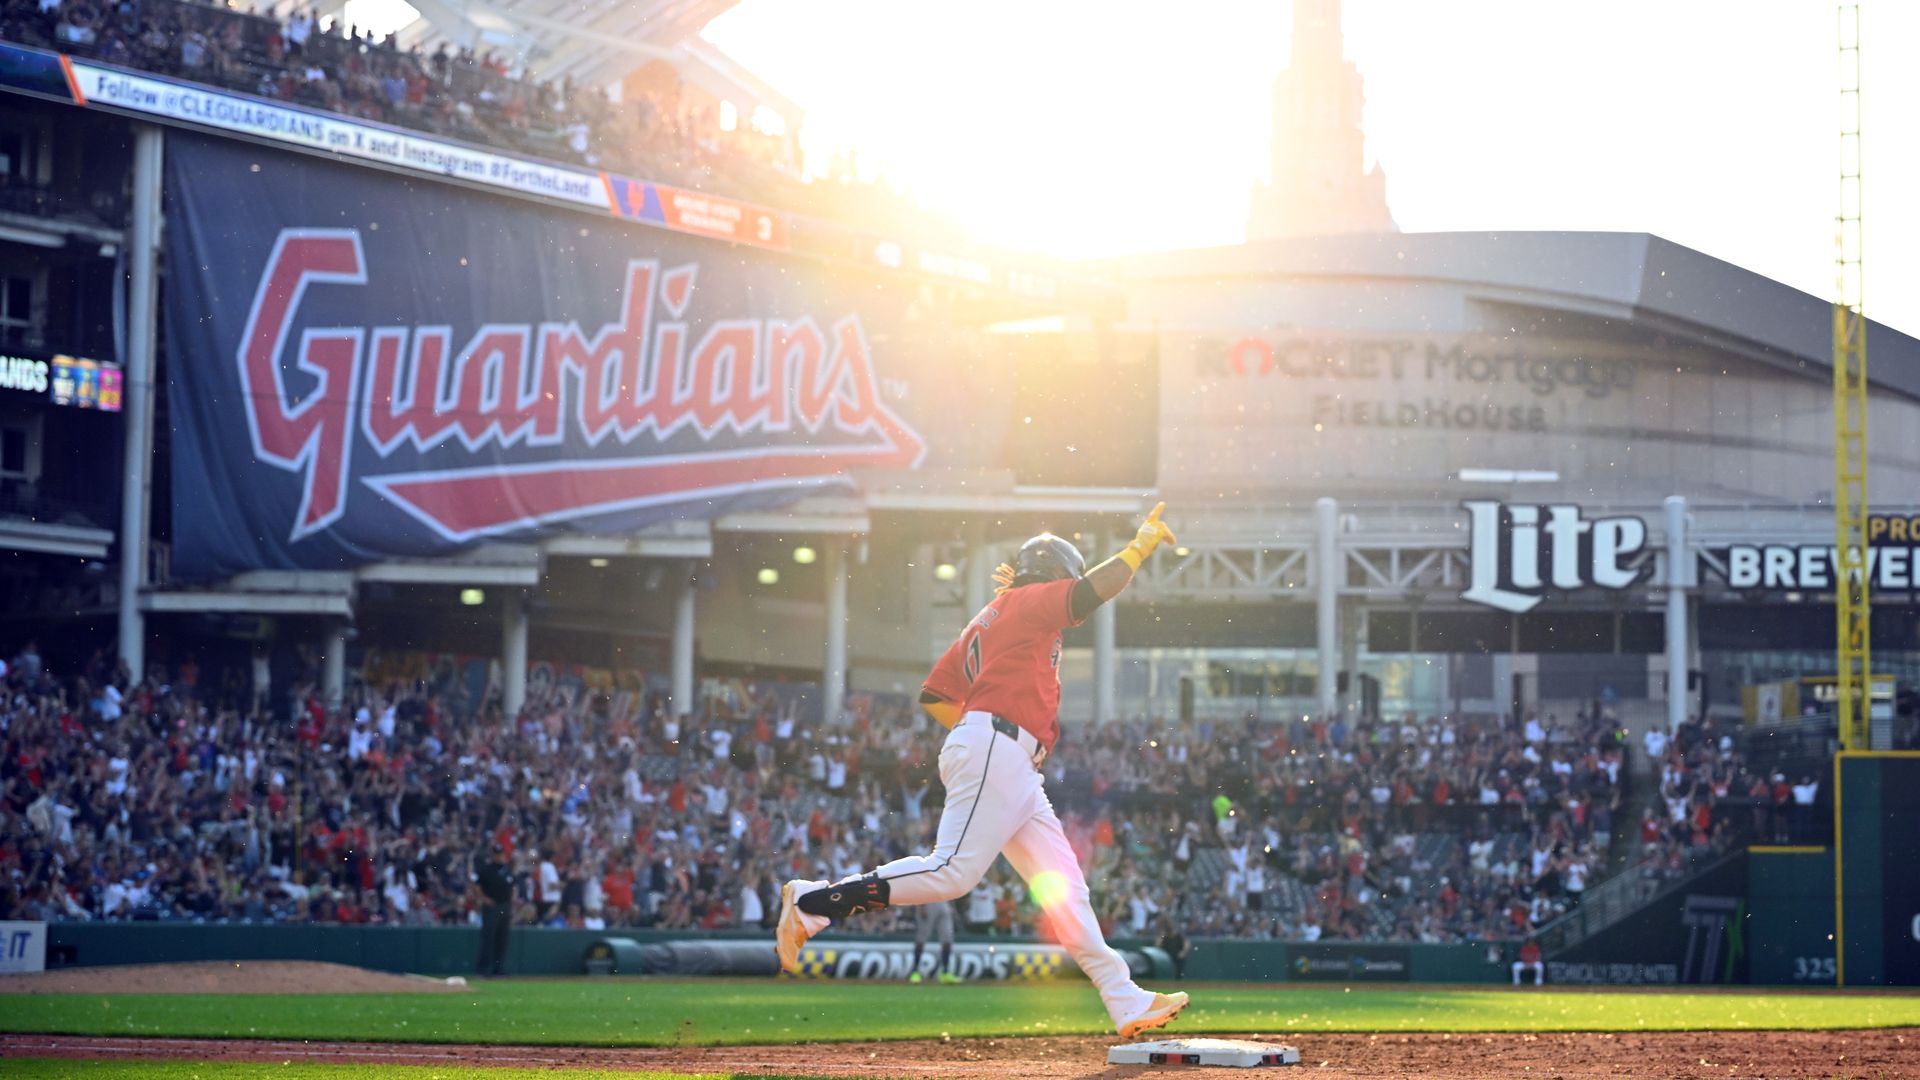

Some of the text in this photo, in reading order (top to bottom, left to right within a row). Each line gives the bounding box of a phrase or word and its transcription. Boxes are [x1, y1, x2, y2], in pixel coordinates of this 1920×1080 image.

[97, 75, 592, 198] Follow @CLEGUARDIANS on X and Instagram #FortheLand
[757, 216, 772, 241] 3
[237, 226, 928, 543] Guardians
[1424, 338, 1639, 397] Mortgage
[1462, 500, 1645, 613] Lite
[1794, 957, 1836, 979] 325
